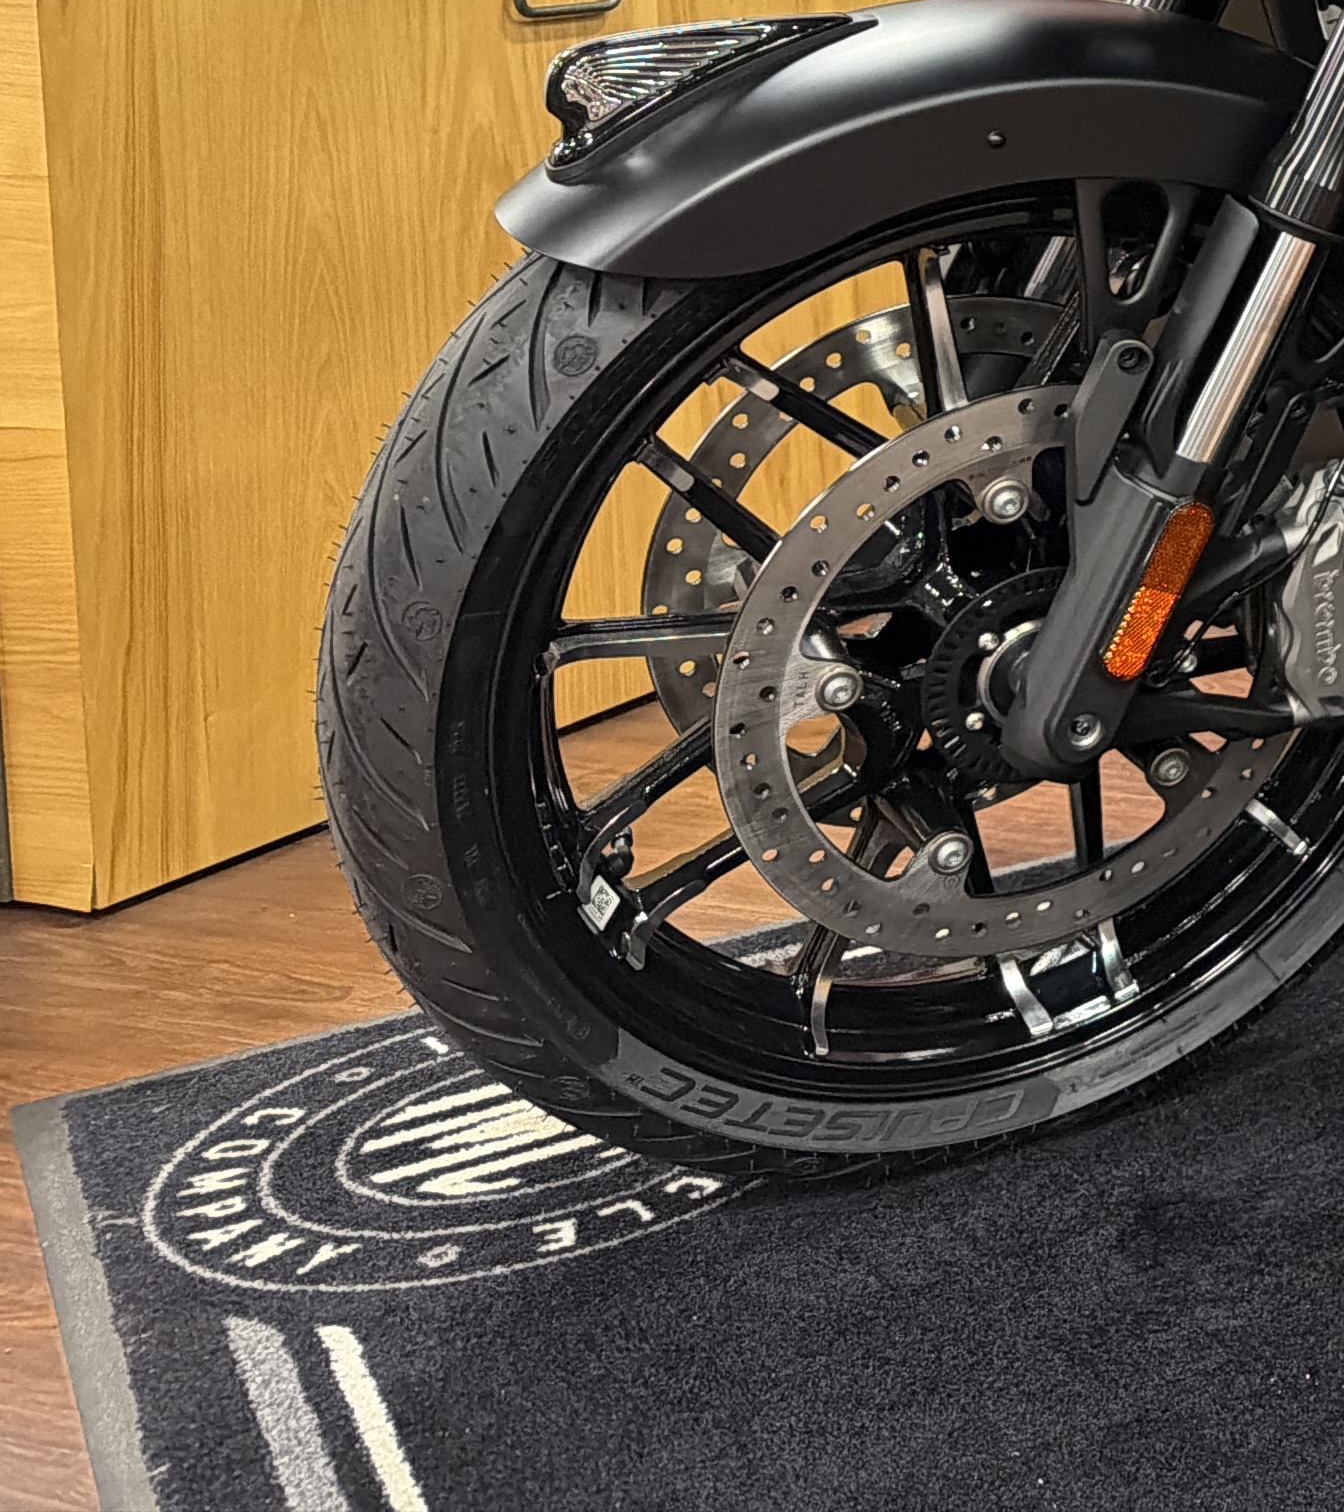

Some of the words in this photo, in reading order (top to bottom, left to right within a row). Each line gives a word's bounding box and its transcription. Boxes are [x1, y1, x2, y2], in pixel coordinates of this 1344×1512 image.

[1313, 568, 1342, 685] brembo
[640, 1066, 1028, 1143] CRUISETEC
[176, 1106, 361, 1276] COMPANY
